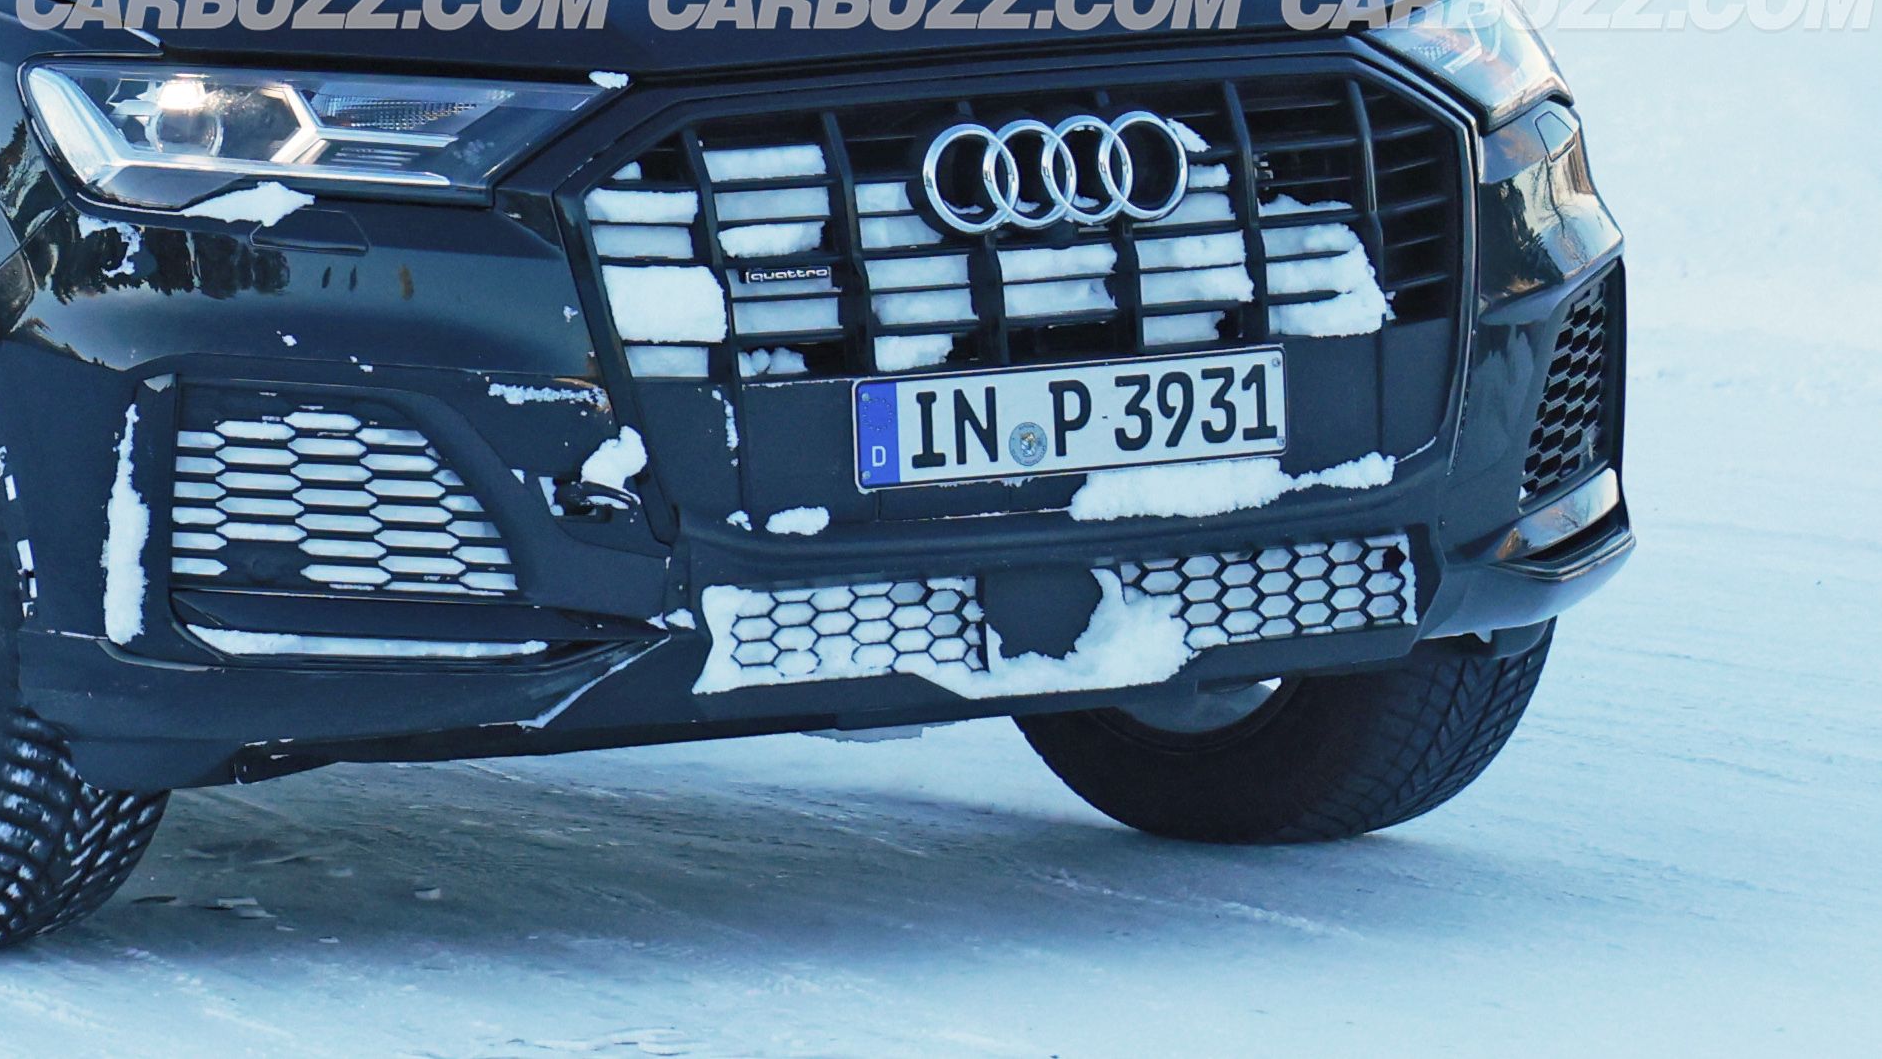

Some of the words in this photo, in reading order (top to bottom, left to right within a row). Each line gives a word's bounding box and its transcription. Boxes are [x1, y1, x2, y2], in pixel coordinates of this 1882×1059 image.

[750, 268, 829, 283] quattro
[911, 386, 999, 469] IN
[1048, 379, 1093, 457] P
[1113, 363, 1278, 452] 3931
[871, 445, 887, 468] D
